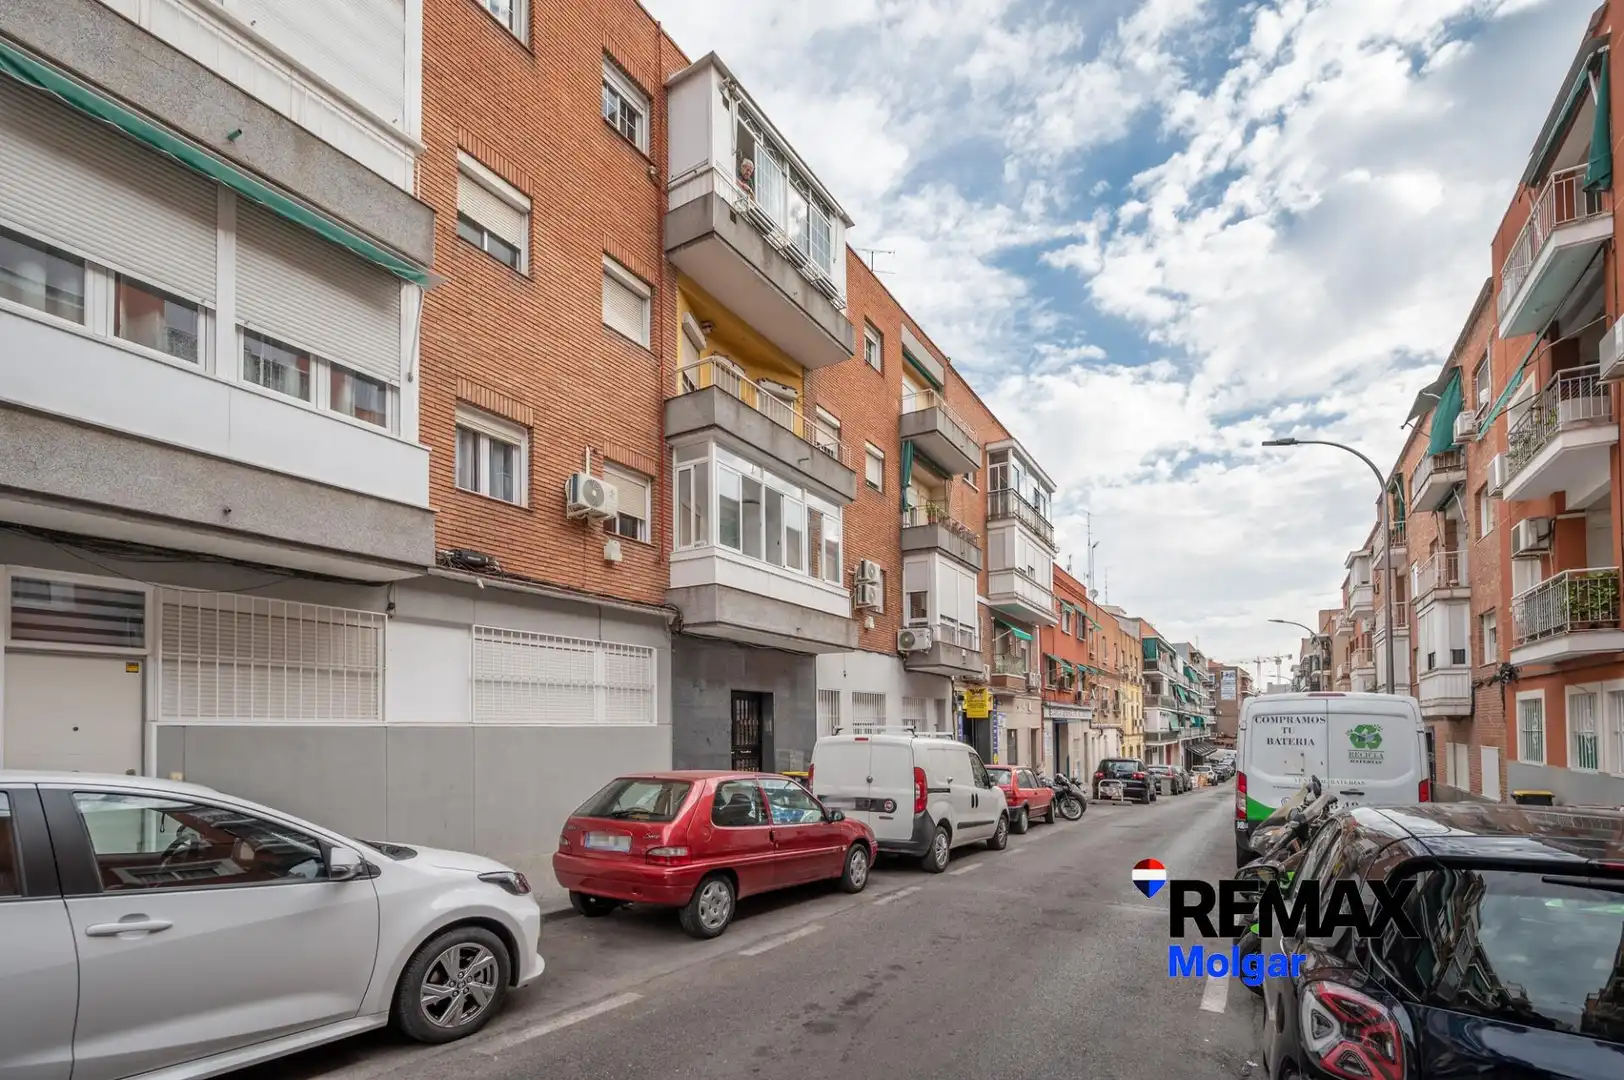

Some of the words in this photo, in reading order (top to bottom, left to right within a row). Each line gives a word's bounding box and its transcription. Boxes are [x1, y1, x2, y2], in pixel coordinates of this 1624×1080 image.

[1255, 716, 1326, 724] COMPRAMOS
[1267, 738, 1315, 746] BATERIA
[1349, 751, 1384, 760] RECICLA
